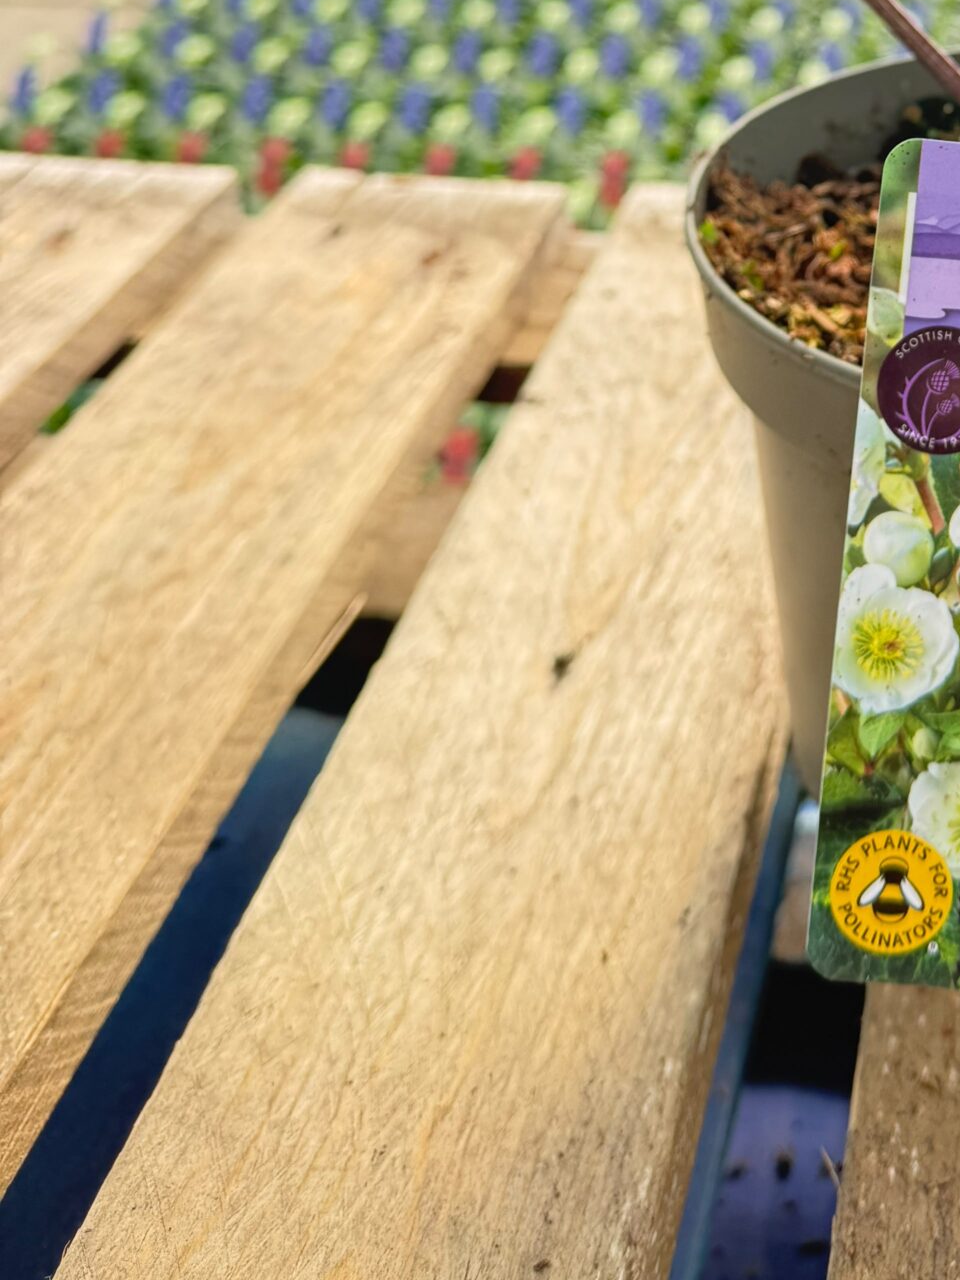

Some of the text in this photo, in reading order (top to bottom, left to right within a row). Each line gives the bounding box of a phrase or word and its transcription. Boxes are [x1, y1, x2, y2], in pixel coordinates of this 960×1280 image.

[895, 330, 953, 359] SCOTTISH
[898, 423, 936, 449] SINCE
[836, 834, 948, 948] RHS PLANTS FOR POLLINATORS
